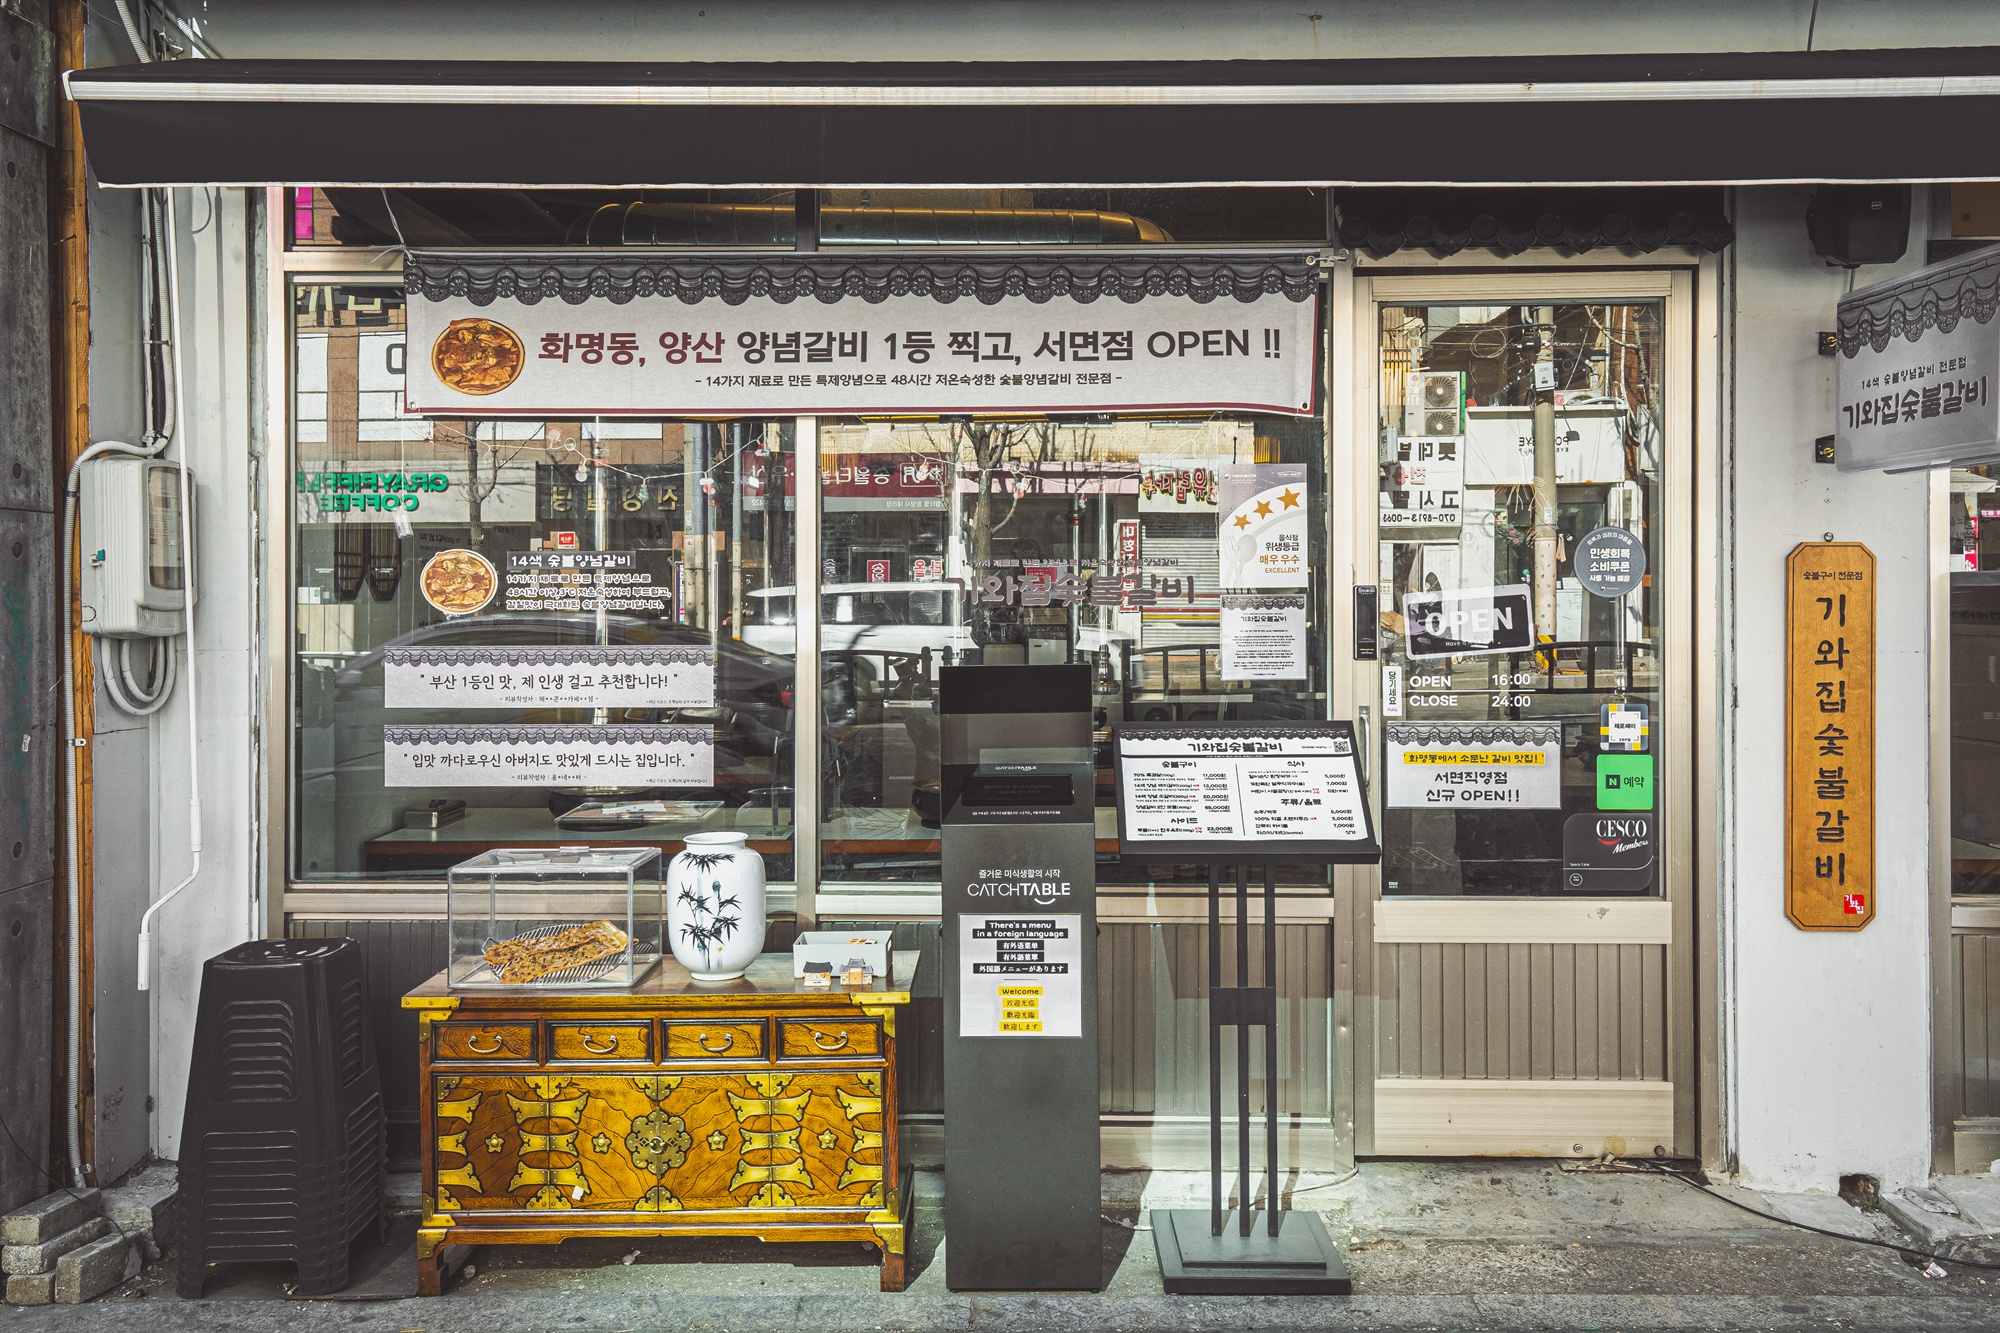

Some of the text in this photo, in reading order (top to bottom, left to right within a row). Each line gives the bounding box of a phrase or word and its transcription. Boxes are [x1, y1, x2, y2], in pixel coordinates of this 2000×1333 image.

[538, 332, 646, 367] 화명동,
[658, 332, 726, 364] 양산
[736, 331, 868, 364] 양념갈비
[884, 331, 935, 364] 1등
[947, 331, 1021, 366] 찍고,
[1032, 330, 1134, 362] 서면점
[1147, 329, 1250, 358] OPEN
[1861, 356, 1967, 389] 14색 숯불양념갈비 전문점
[706, 373, 1112, 388] 14가지 재료로 만든 특제양념으로 48시간 저온숙성한 숯불양념갈비 전문점
[1842, 376, 1988, 429] 기와집숯불갈비
[1278, 534, 1299, 542] 음식점
[1265, 542, 1300, 552] 위생등급
[1589, 548, 1630, 559] 민생회복
[511, 554, 633, 568] 14색 숯불양념갈비
[1259, 554, 1300, 565] 매우 우수
[1589, 561, 1630, 572] 소비쿠폰
[1803, 571, 1863, 581] 숯불구이 전문점
[506, 587, 537, 599] 48시간
[943, 572, 1196, 608] 기와집숯불갈비
[1424, 607, 1513, 637] OPEN
[429, 674, 669, 690] 부산 1등인 맛, 제 인생 걸고 추천합니다!
[1409, 673, 1531, 687] OPEN 16:00
[1388, 671, 1397, 705] 당기세요
[1409, 695, 1531, 707] CLOSE 24:00
[1813, 593, 1850, 886] 기와집숯불갈비
[1188, 742, 1282, 753] 기와집숯불갈비
[412, 753, 685, 769] 입맛 까다로우신 아버지도 맛있게 드시는 집입니다.
[1162, 761, 1197, 769] 숯불구이
[1408, 753, 1539, 763] 화명동에서 소문난 갈비 맛집!
[1434, 771, 1508, 785] 서면직영점
[1623, 776, 1645, 788] 예약
[1426, 789, 1521, 802] 신규 OPEN!!
[1595, 819, 1648, 838] CESCO
[1612, 838, 1650, 854] Members
[978, 869, 1061, 879] 즐거운 미식생활의 시작
[967, 882, 1071, 897] CATCHTABLE
[993, 930, 1025, 939] foreign
[1026, 930, 1064, 939] language
